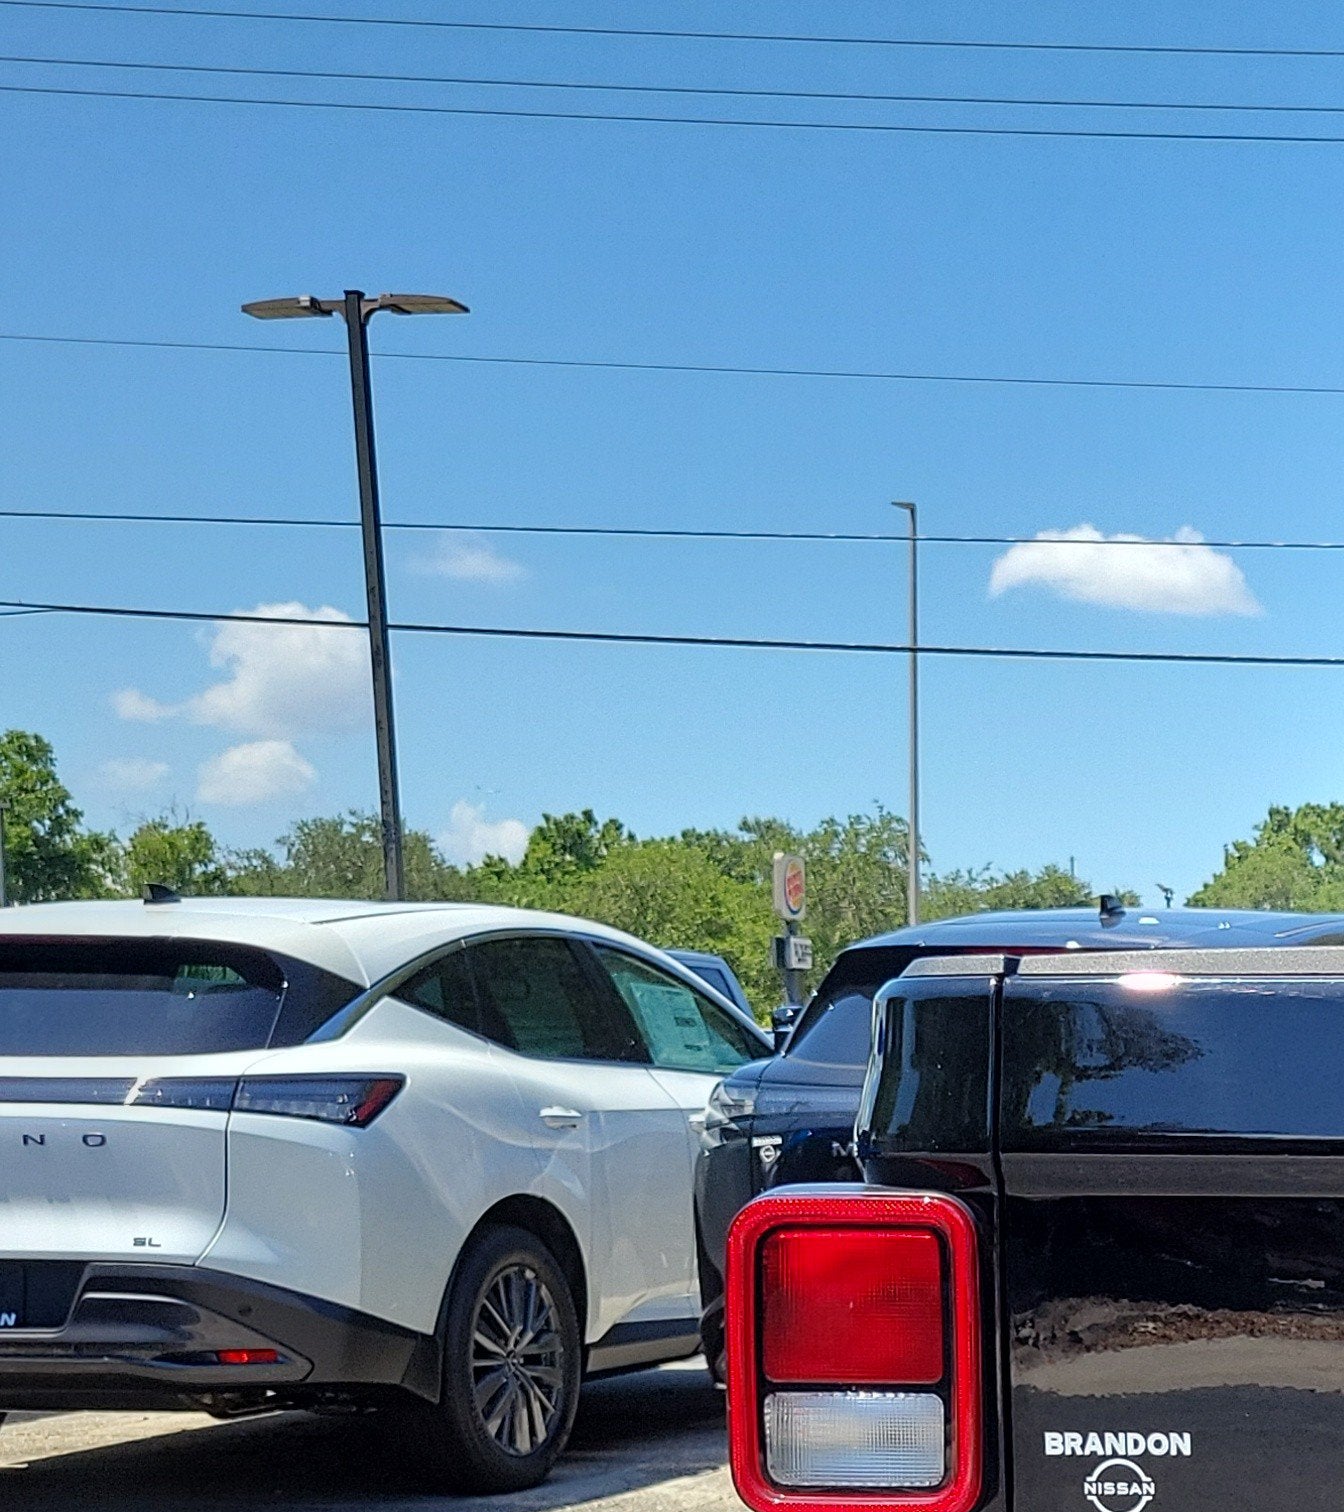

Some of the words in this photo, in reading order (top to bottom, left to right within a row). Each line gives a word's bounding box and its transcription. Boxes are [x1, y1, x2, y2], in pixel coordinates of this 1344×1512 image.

[133, 1237, 161, 1247] SL
[1043, 1431, 1192, 1456] BRANDON
[1084, 1481, 1155, 1495] NISSAN
